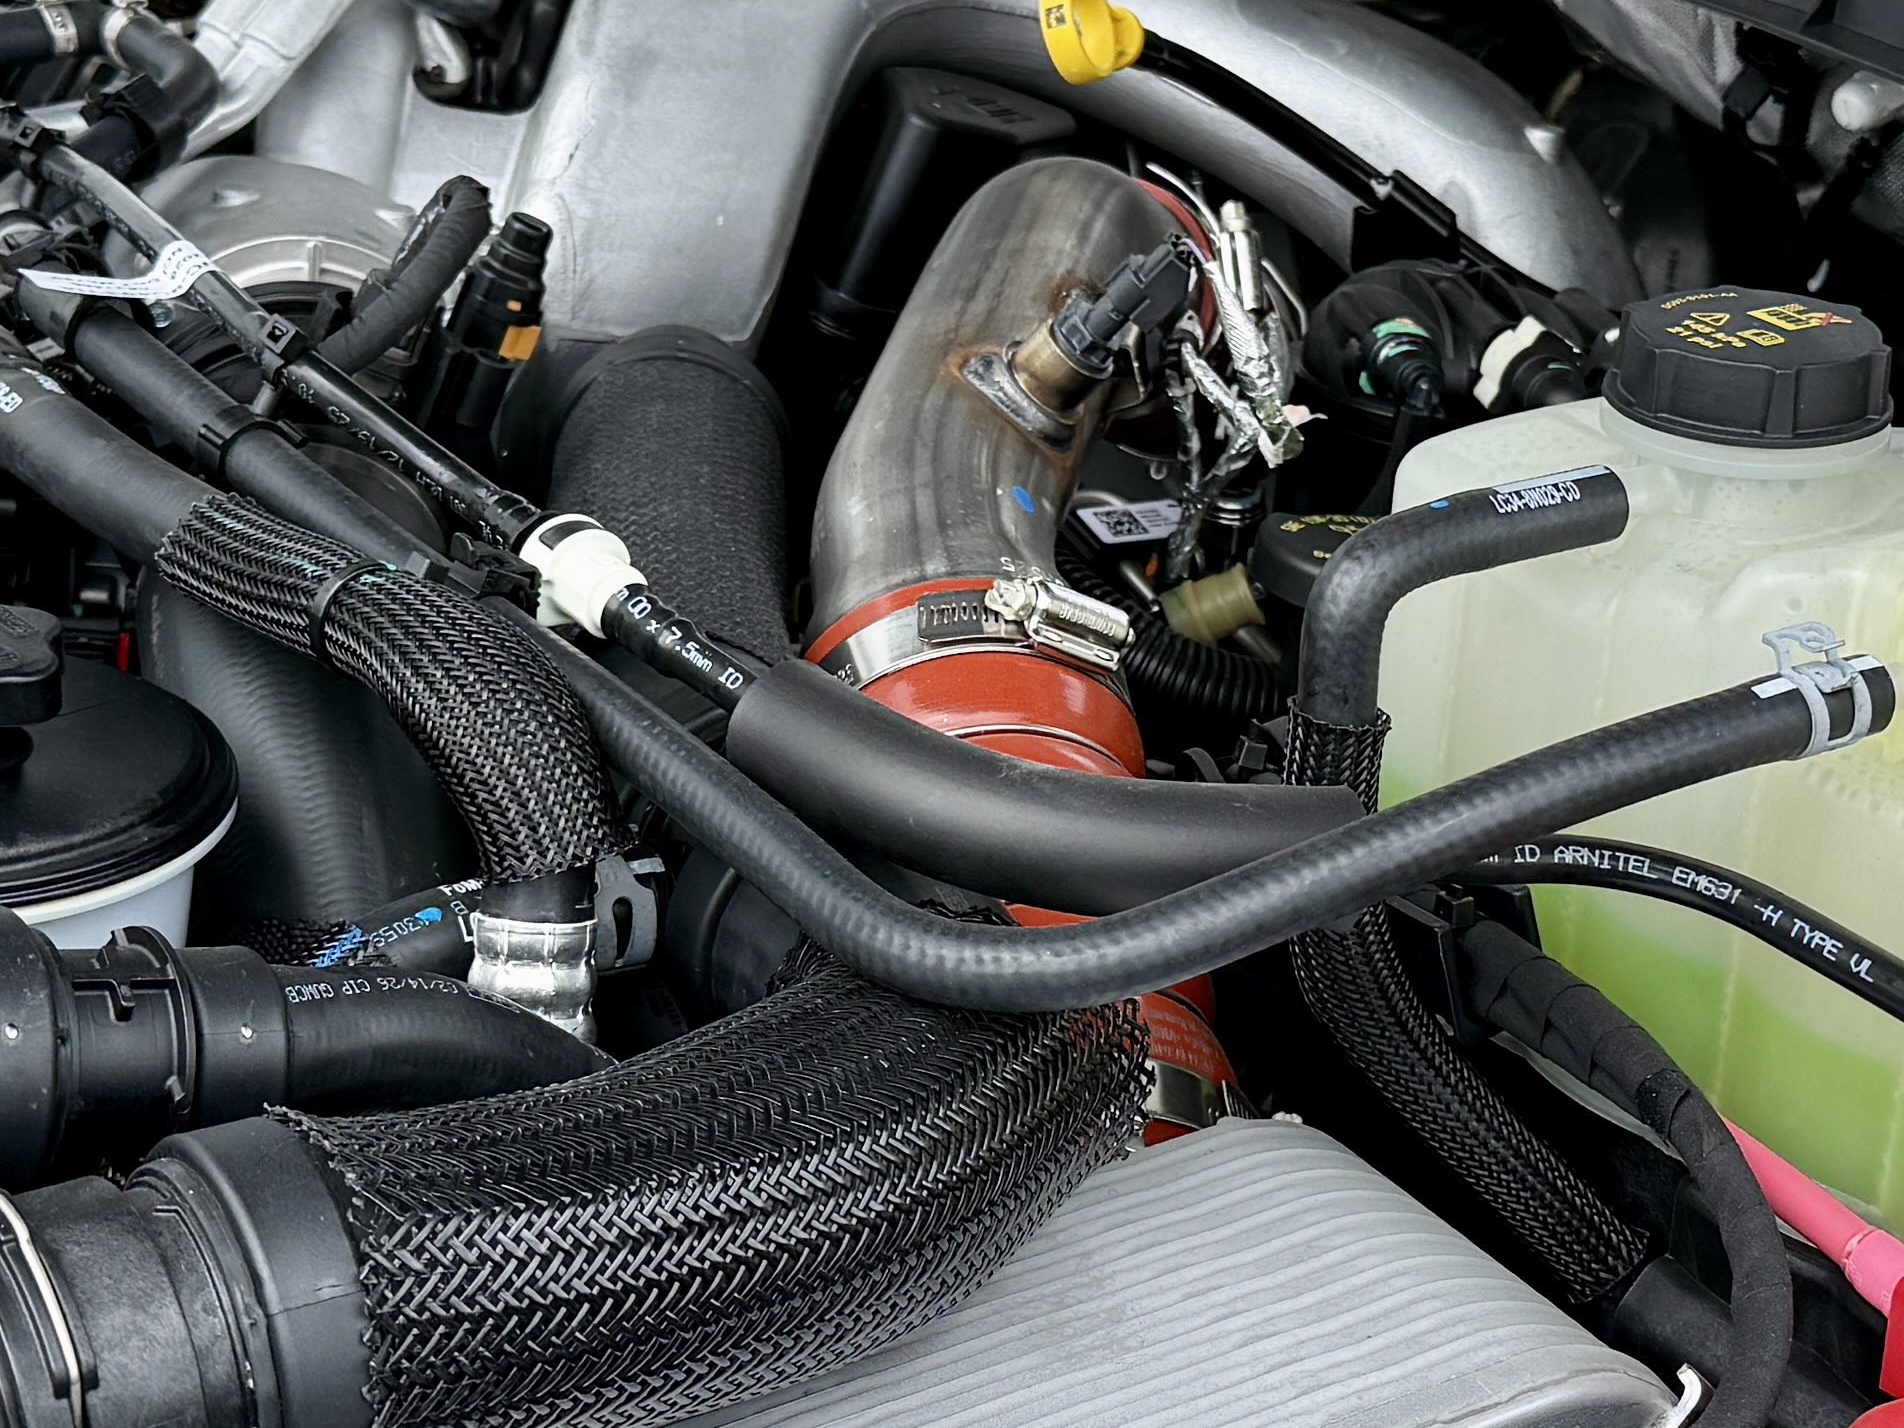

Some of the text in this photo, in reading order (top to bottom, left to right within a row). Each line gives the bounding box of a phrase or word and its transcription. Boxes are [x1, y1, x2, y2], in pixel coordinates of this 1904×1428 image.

[660, 625, 713, 672] 7.5mm
[1554, 845, 1659, 879] ARNITEL
[1671, 867, 1742, 904] EM631
[1791, 918, 1843, 961] TYPE
[344, 977, 372, 996] CIP
